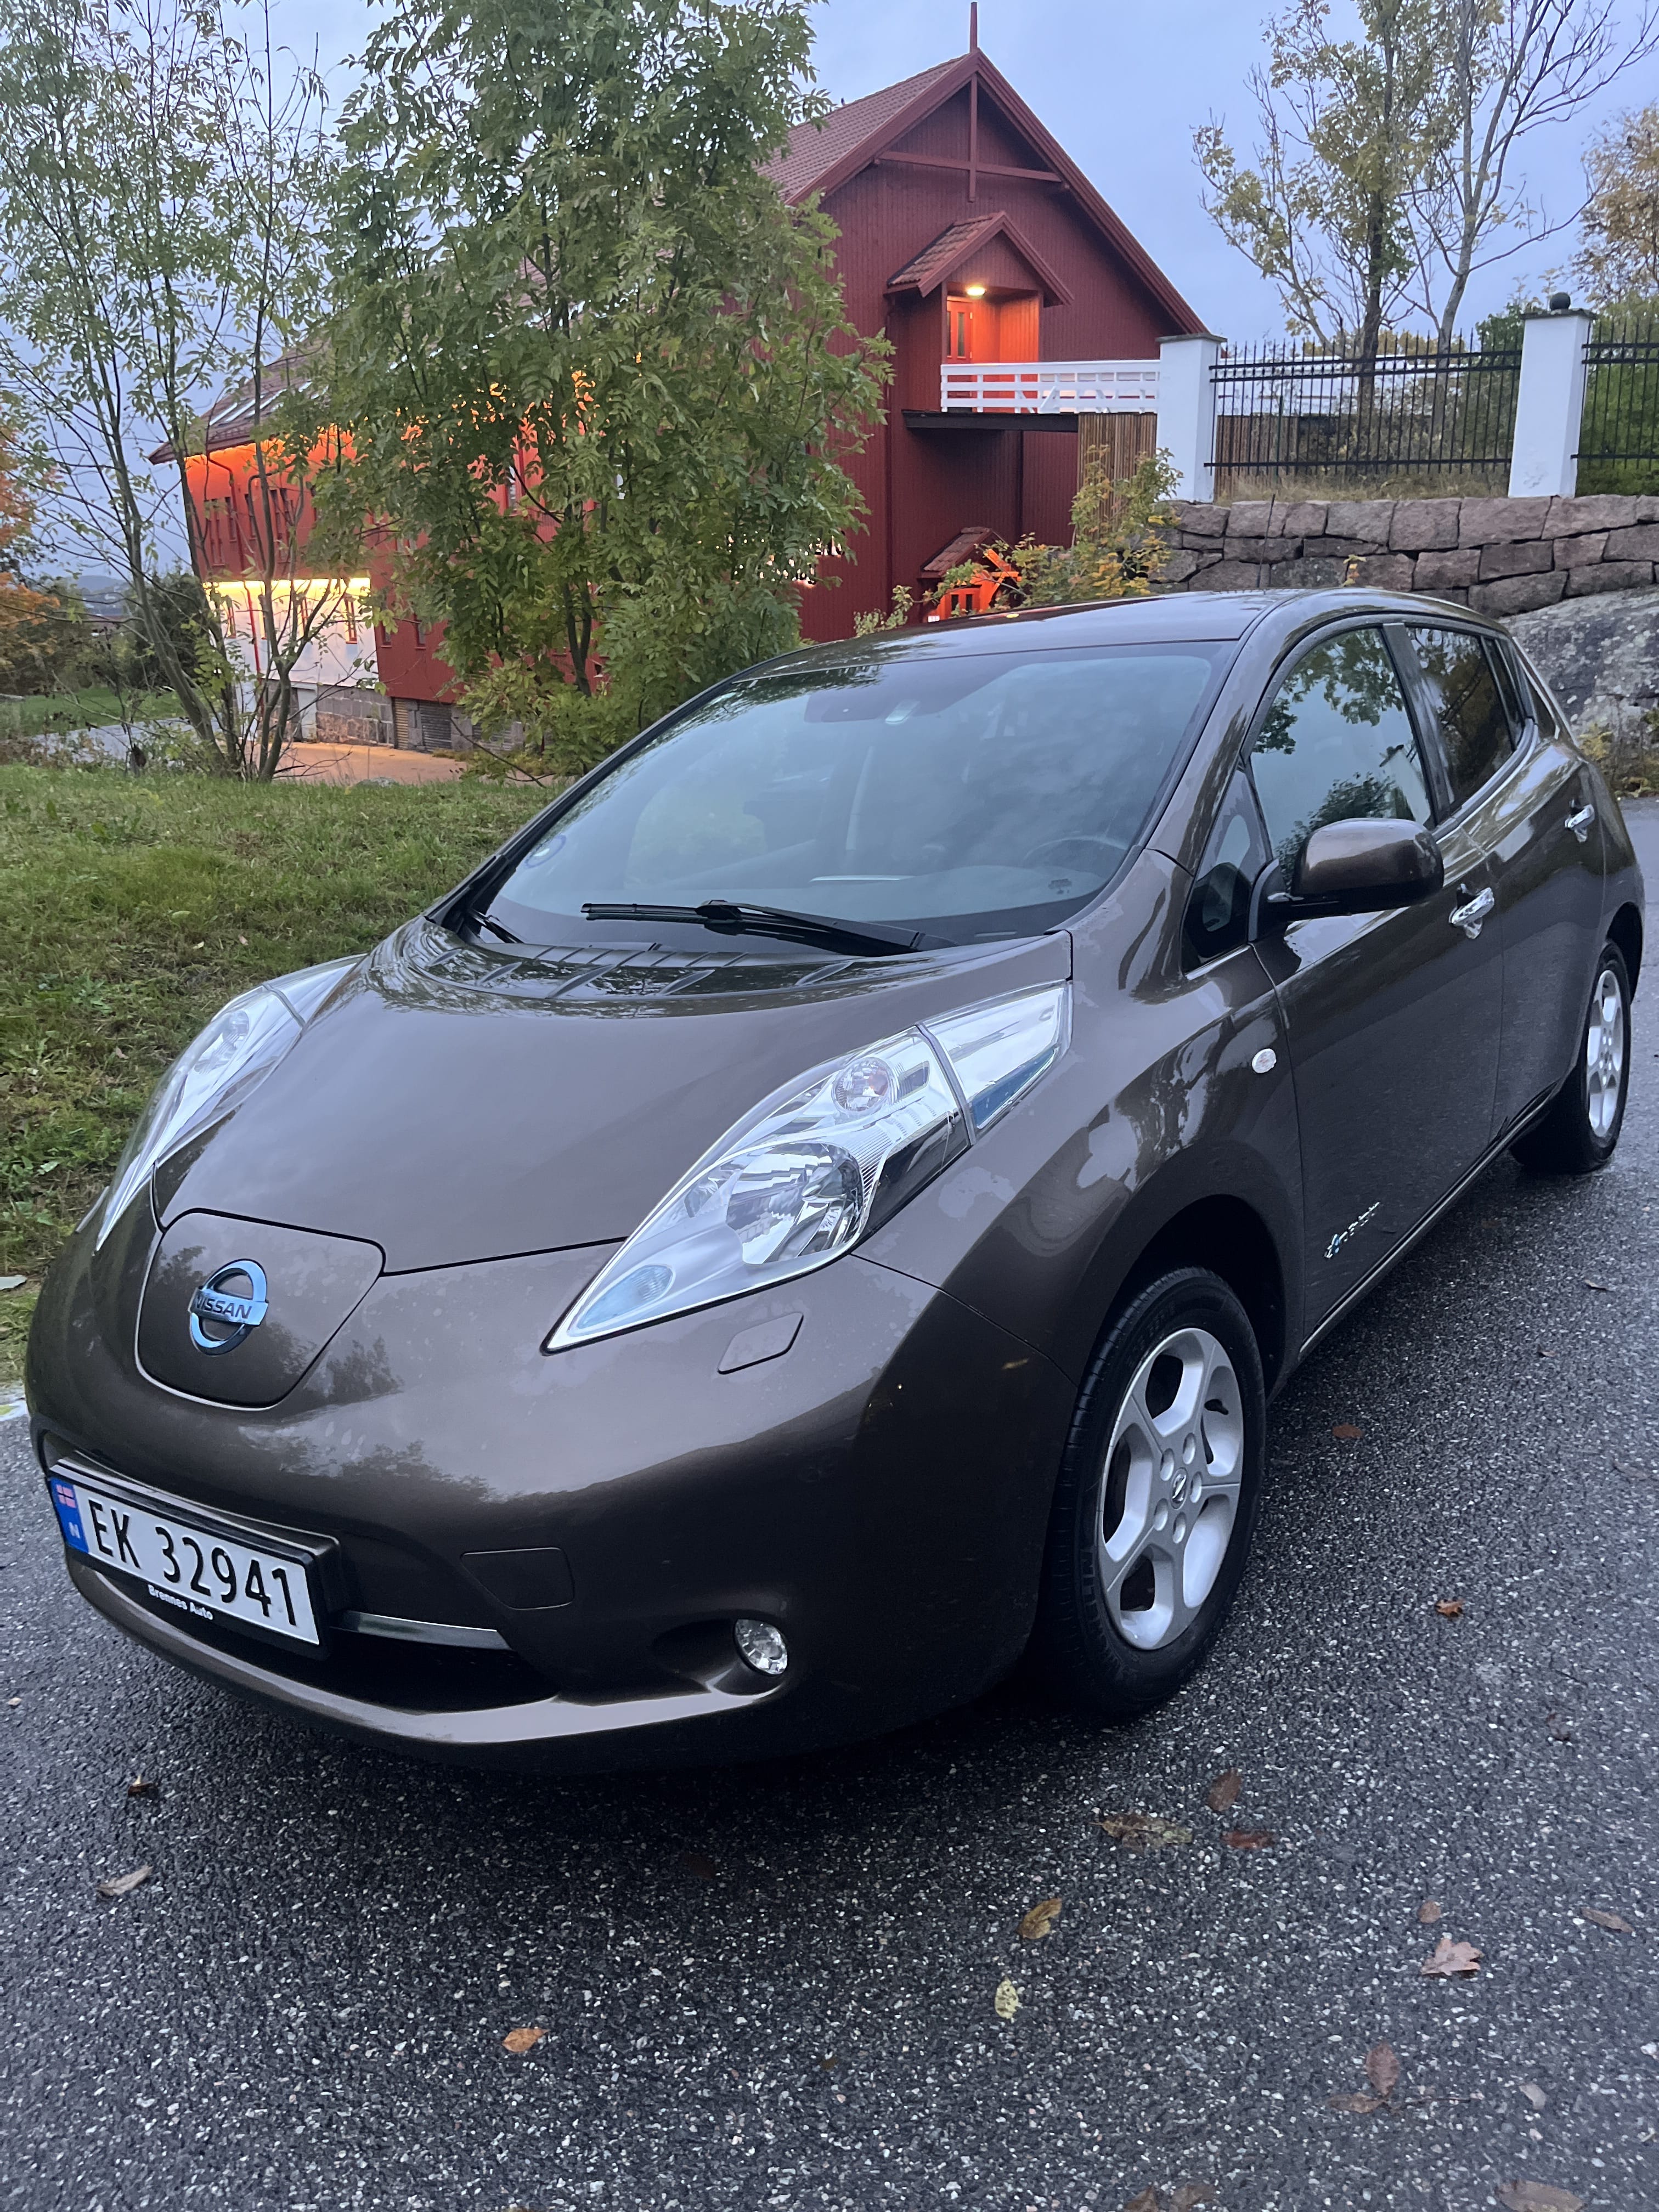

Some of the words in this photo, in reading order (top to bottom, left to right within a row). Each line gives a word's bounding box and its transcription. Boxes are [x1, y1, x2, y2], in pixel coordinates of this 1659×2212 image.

[195, 1294, 252, 1319] NISSAN
[69, 1521, 81, 1539] N
[88, 1499, 140, 1569] EK
[155, 1526, 296, 1626] 32941
[189, 1601, 213, 1621] Auto
